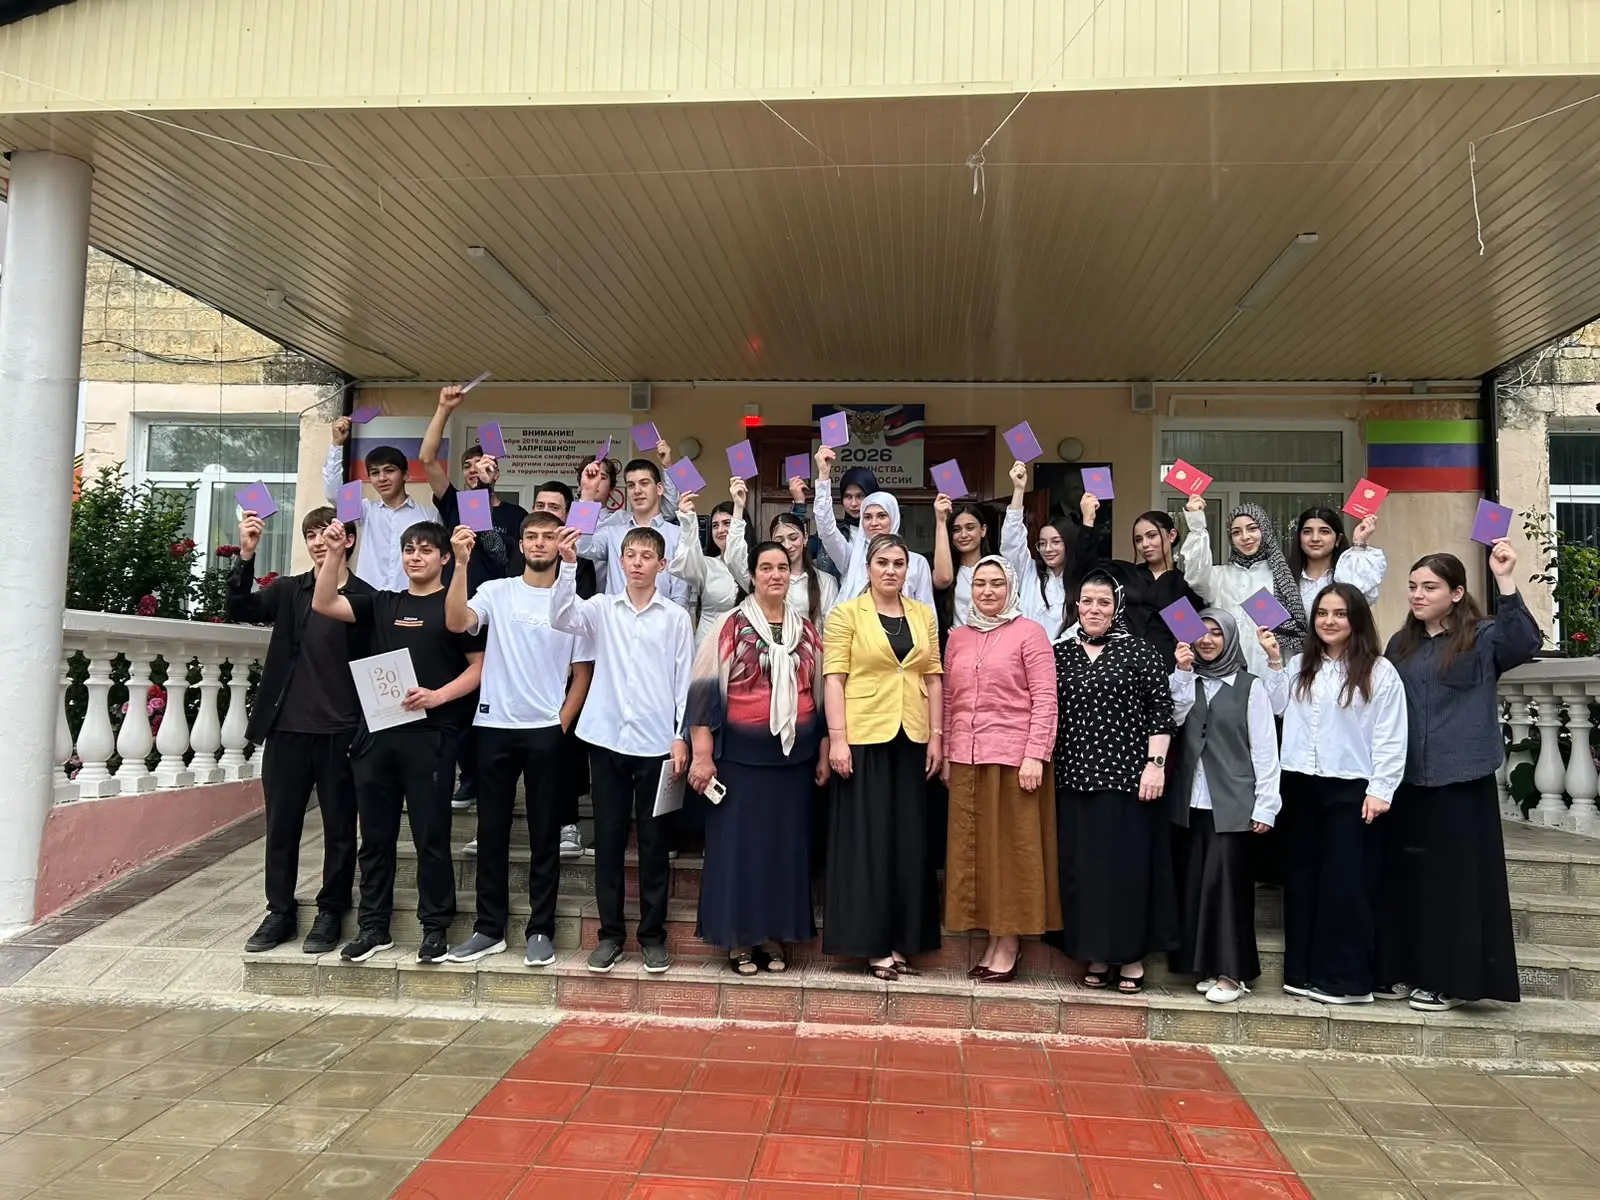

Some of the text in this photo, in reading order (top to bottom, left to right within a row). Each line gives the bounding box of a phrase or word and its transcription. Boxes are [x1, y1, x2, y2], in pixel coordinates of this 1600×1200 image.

[840, 448, 893, 462] 2026
[877, 476, 913, 484] ОССИИ
[374, 667, 396, 684] 20
[379, 682, 401, 698] 26
